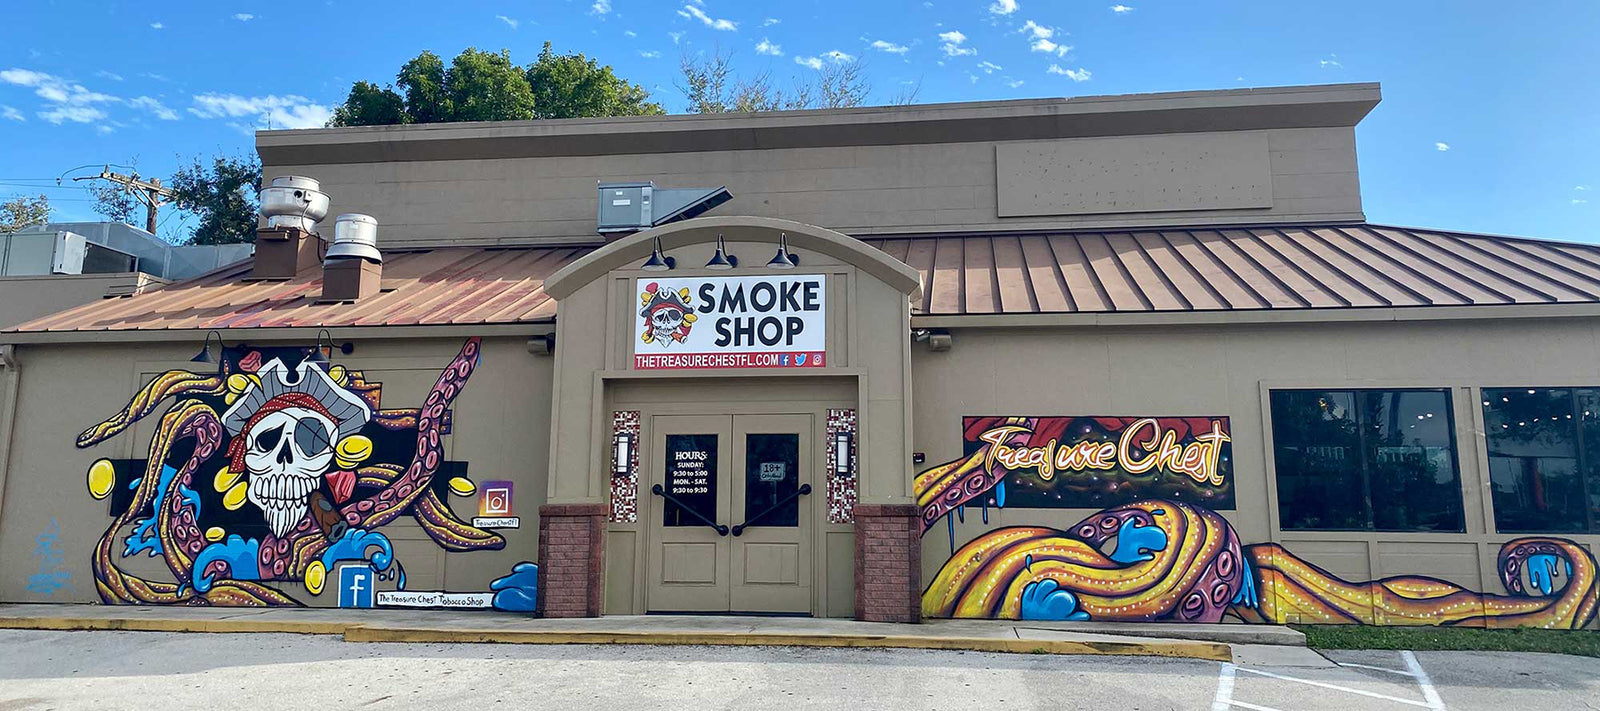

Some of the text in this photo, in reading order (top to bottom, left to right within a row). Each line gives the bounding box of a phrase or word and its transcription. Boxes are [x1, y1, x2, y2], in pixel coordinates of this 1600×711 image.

[698, 281, 821, 314] SMOKE
[714, 316, 804, 347] SHOP
[636, 353, 779, 367] THETREASURECHESTFL.COM
[979, 417, 1231, 486] Treasure Chest
[379, 593, 484, 607] The Treasure Chest Tobacco Shop
